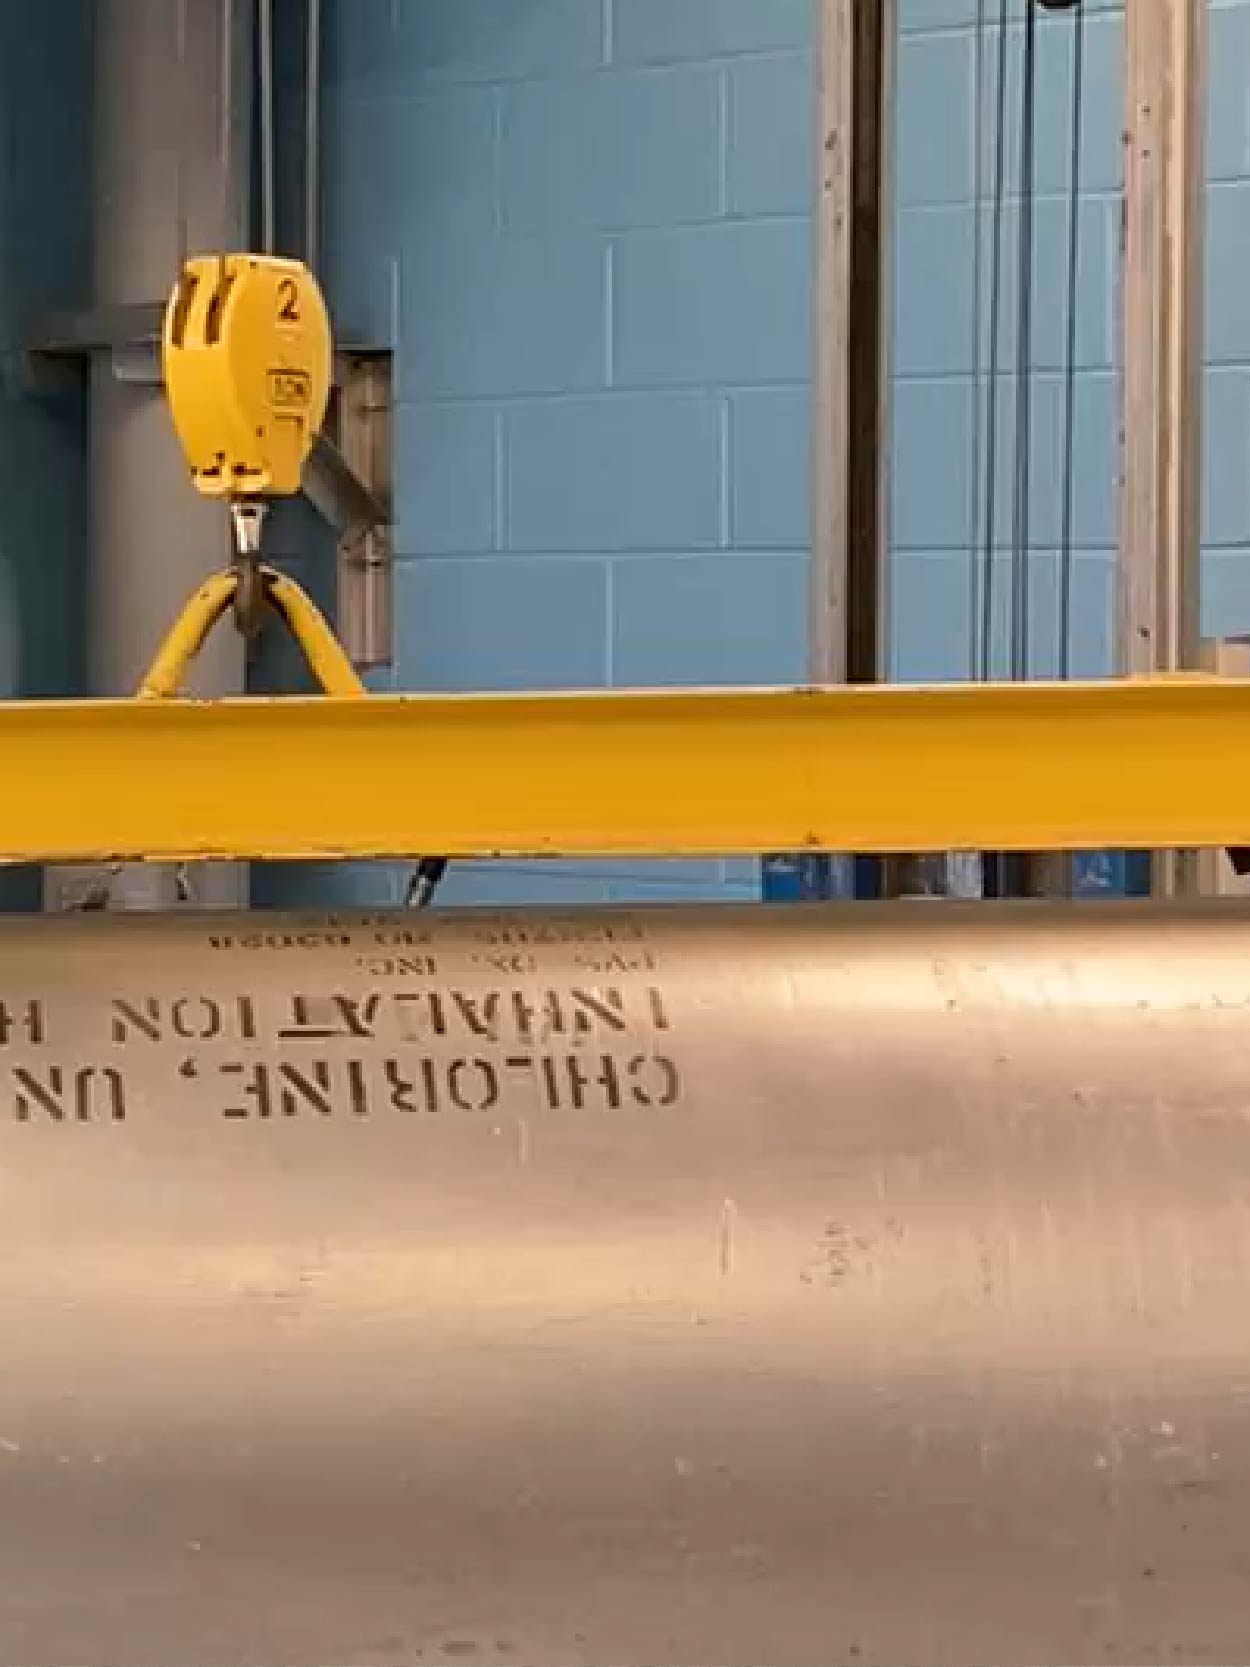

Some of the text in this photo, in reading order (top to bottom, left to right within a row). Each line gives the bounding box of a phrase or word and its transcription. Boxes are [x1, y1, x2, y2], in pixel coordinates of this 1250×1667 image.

[277, 277, 301, 322] 2
[111, 988, 670, 1044] INHALATION
[11, 1056, 681, 1121] CHLORINE, UN
